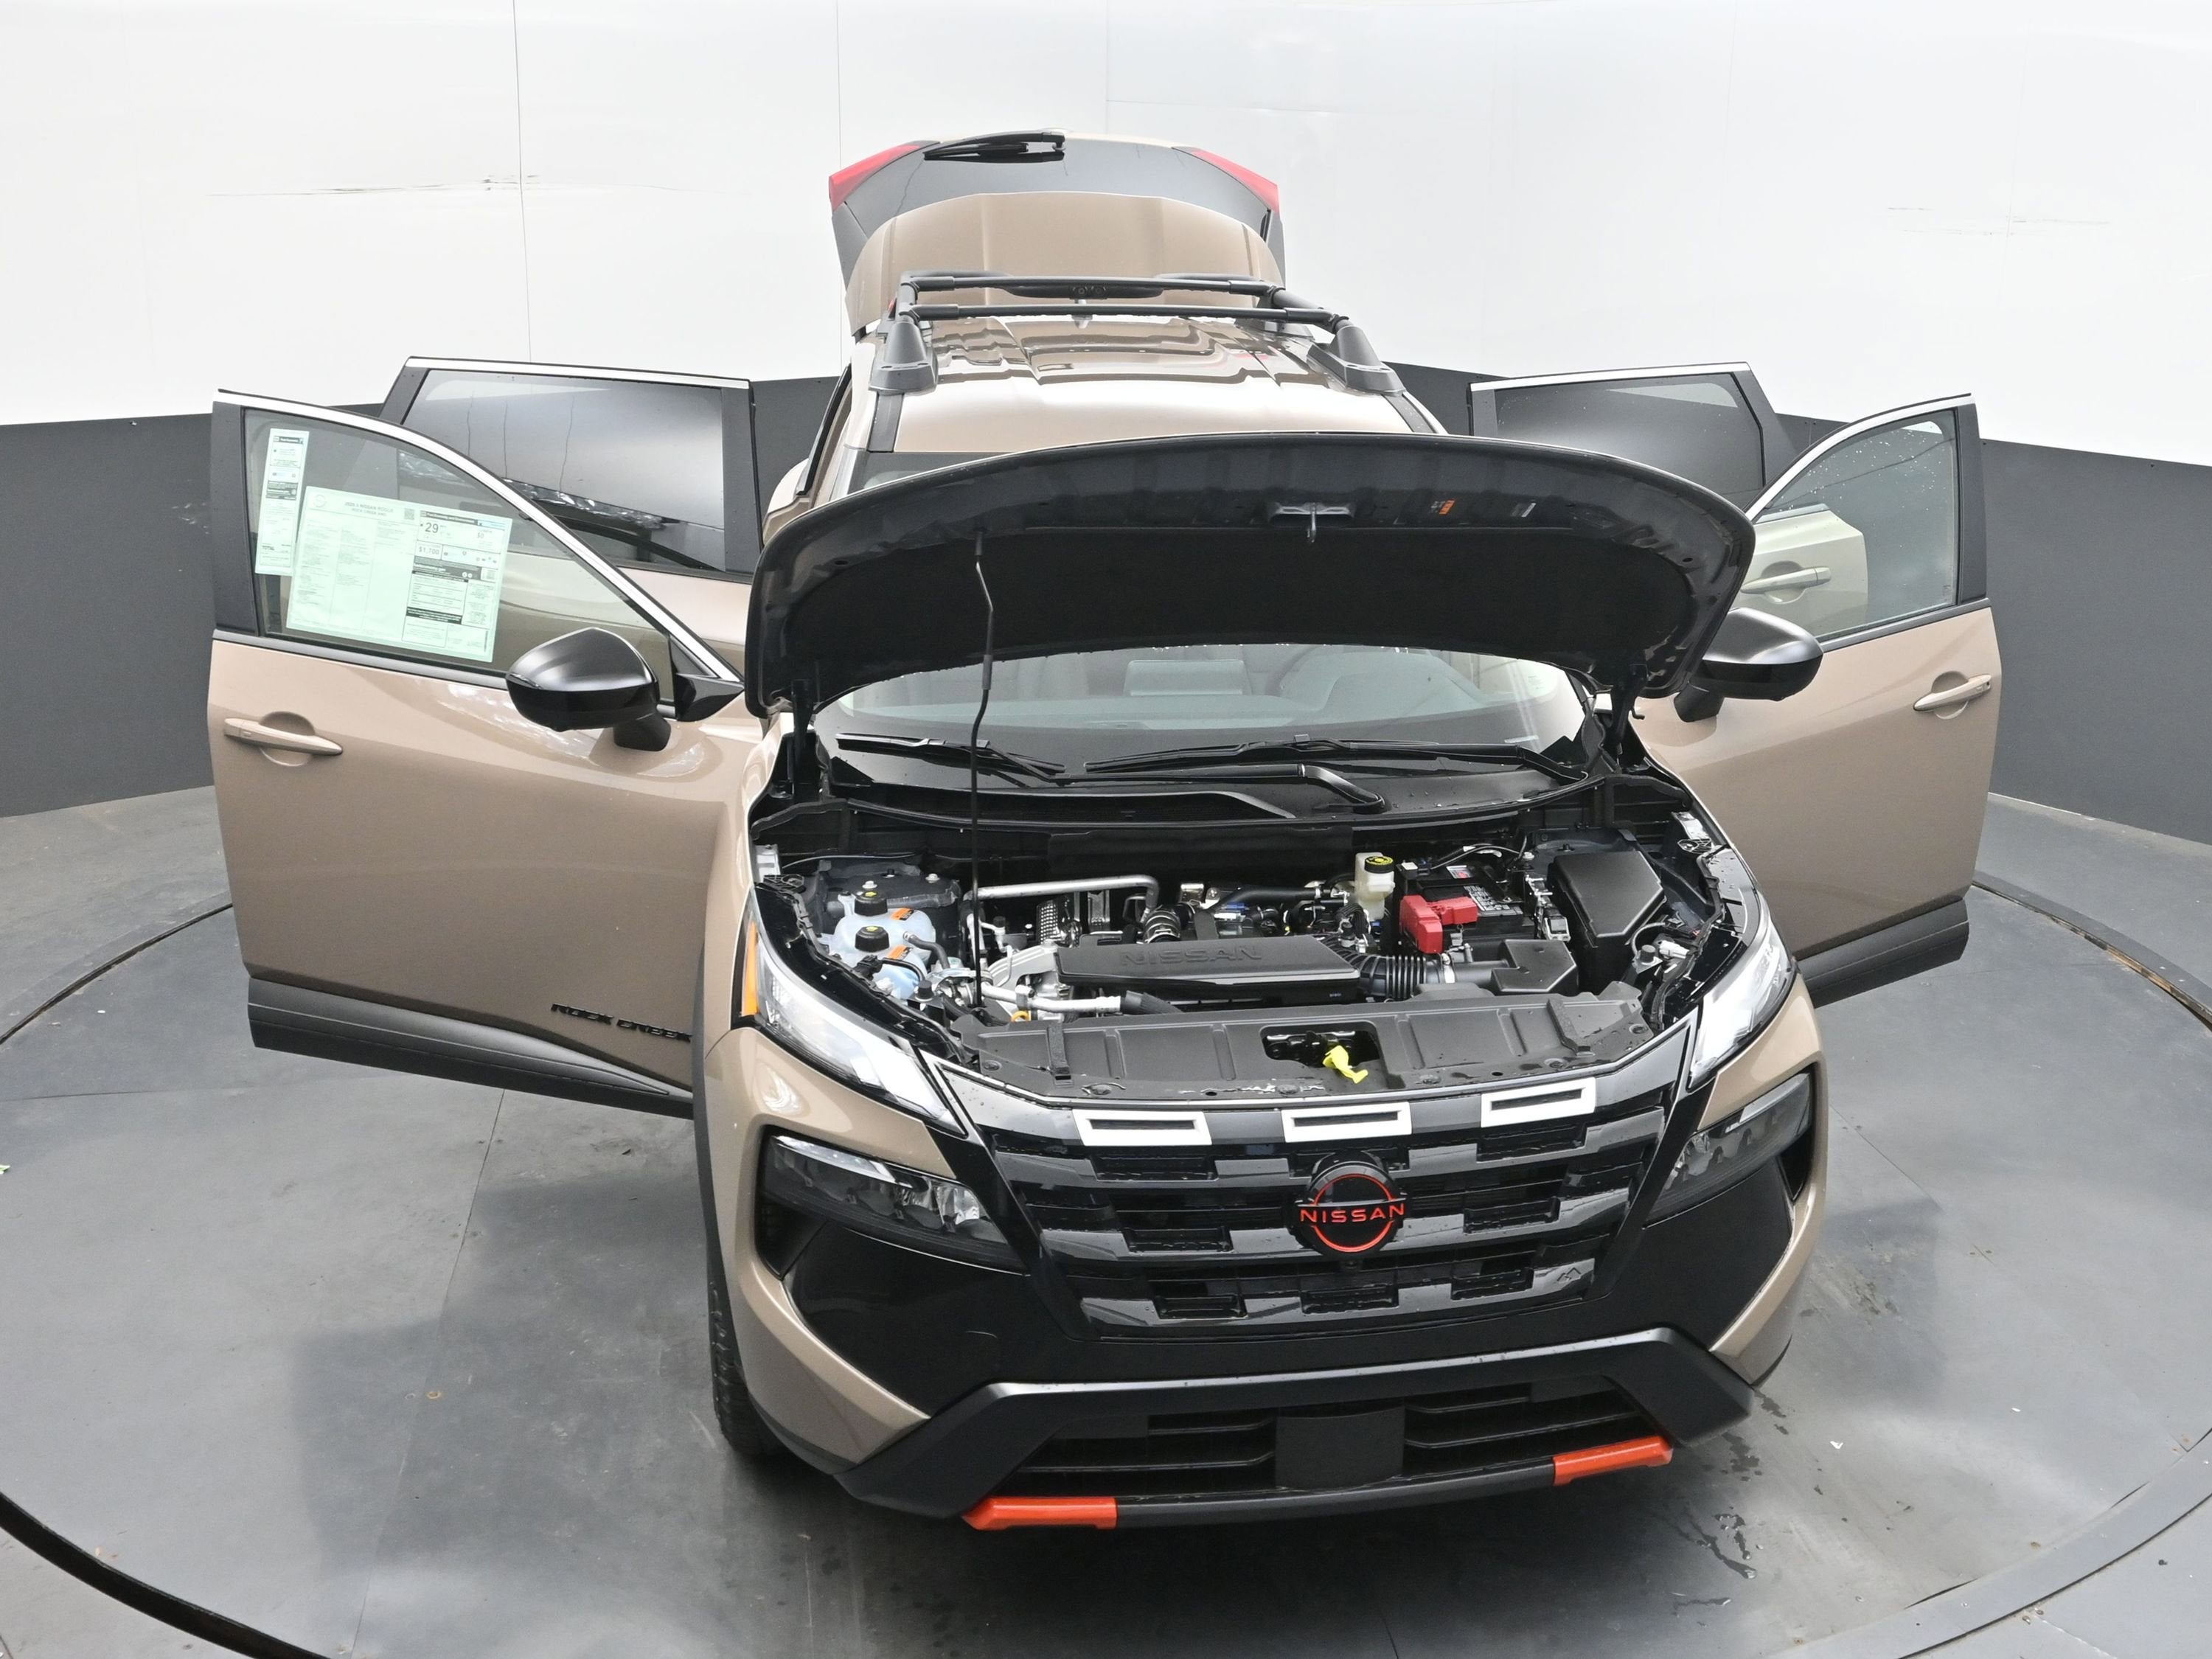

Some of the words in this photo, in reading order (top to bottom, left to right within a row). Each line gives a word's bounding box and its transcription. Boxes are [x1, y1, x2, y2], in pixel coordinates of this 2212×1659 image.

[425, 522, 439, 533] 29
[1121, 945, 1262, 966] NISSAN
[1300, 1203, 1405, 1223] NISSAN
